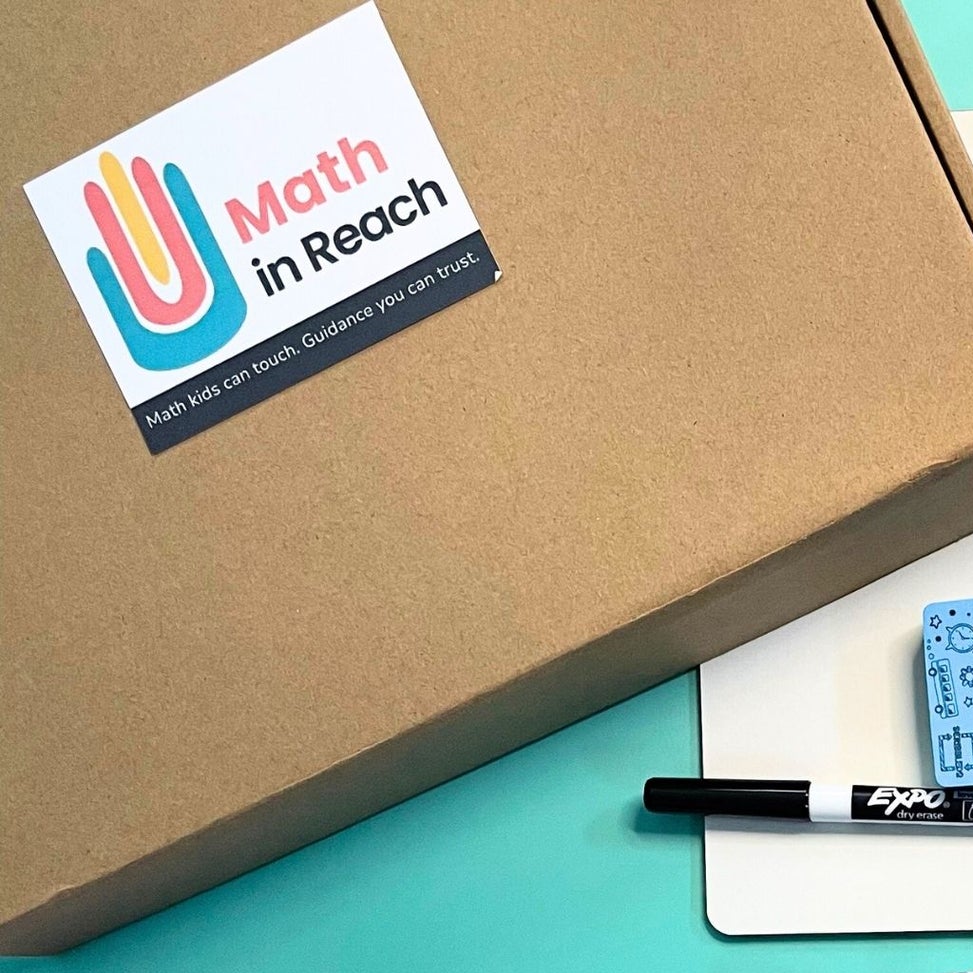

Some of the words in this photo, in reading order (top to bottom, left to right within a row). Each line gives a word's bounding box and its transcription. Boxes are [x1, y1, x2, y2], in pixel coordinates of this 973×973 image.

[225, 137, 390, 245] Math
[251, 257, 303, 297] in
[301, 177, 449, 272] Reach
[145, 402, 188, 430] Math
[188, 382, 222, 414] kids
[223, 368, 251, 390] can
[252, 344, 301, 378] touch.
[301, 305, 374, 350] Guidance
[376, 289, 406, 315] you
[407, 275, 436, 297] can
[437, 251, 481, 285] trust.
[867, 787, 945, 816] EXPO
[896, 809, 915, 821] dry
[916, 812, 945, 821] erase
